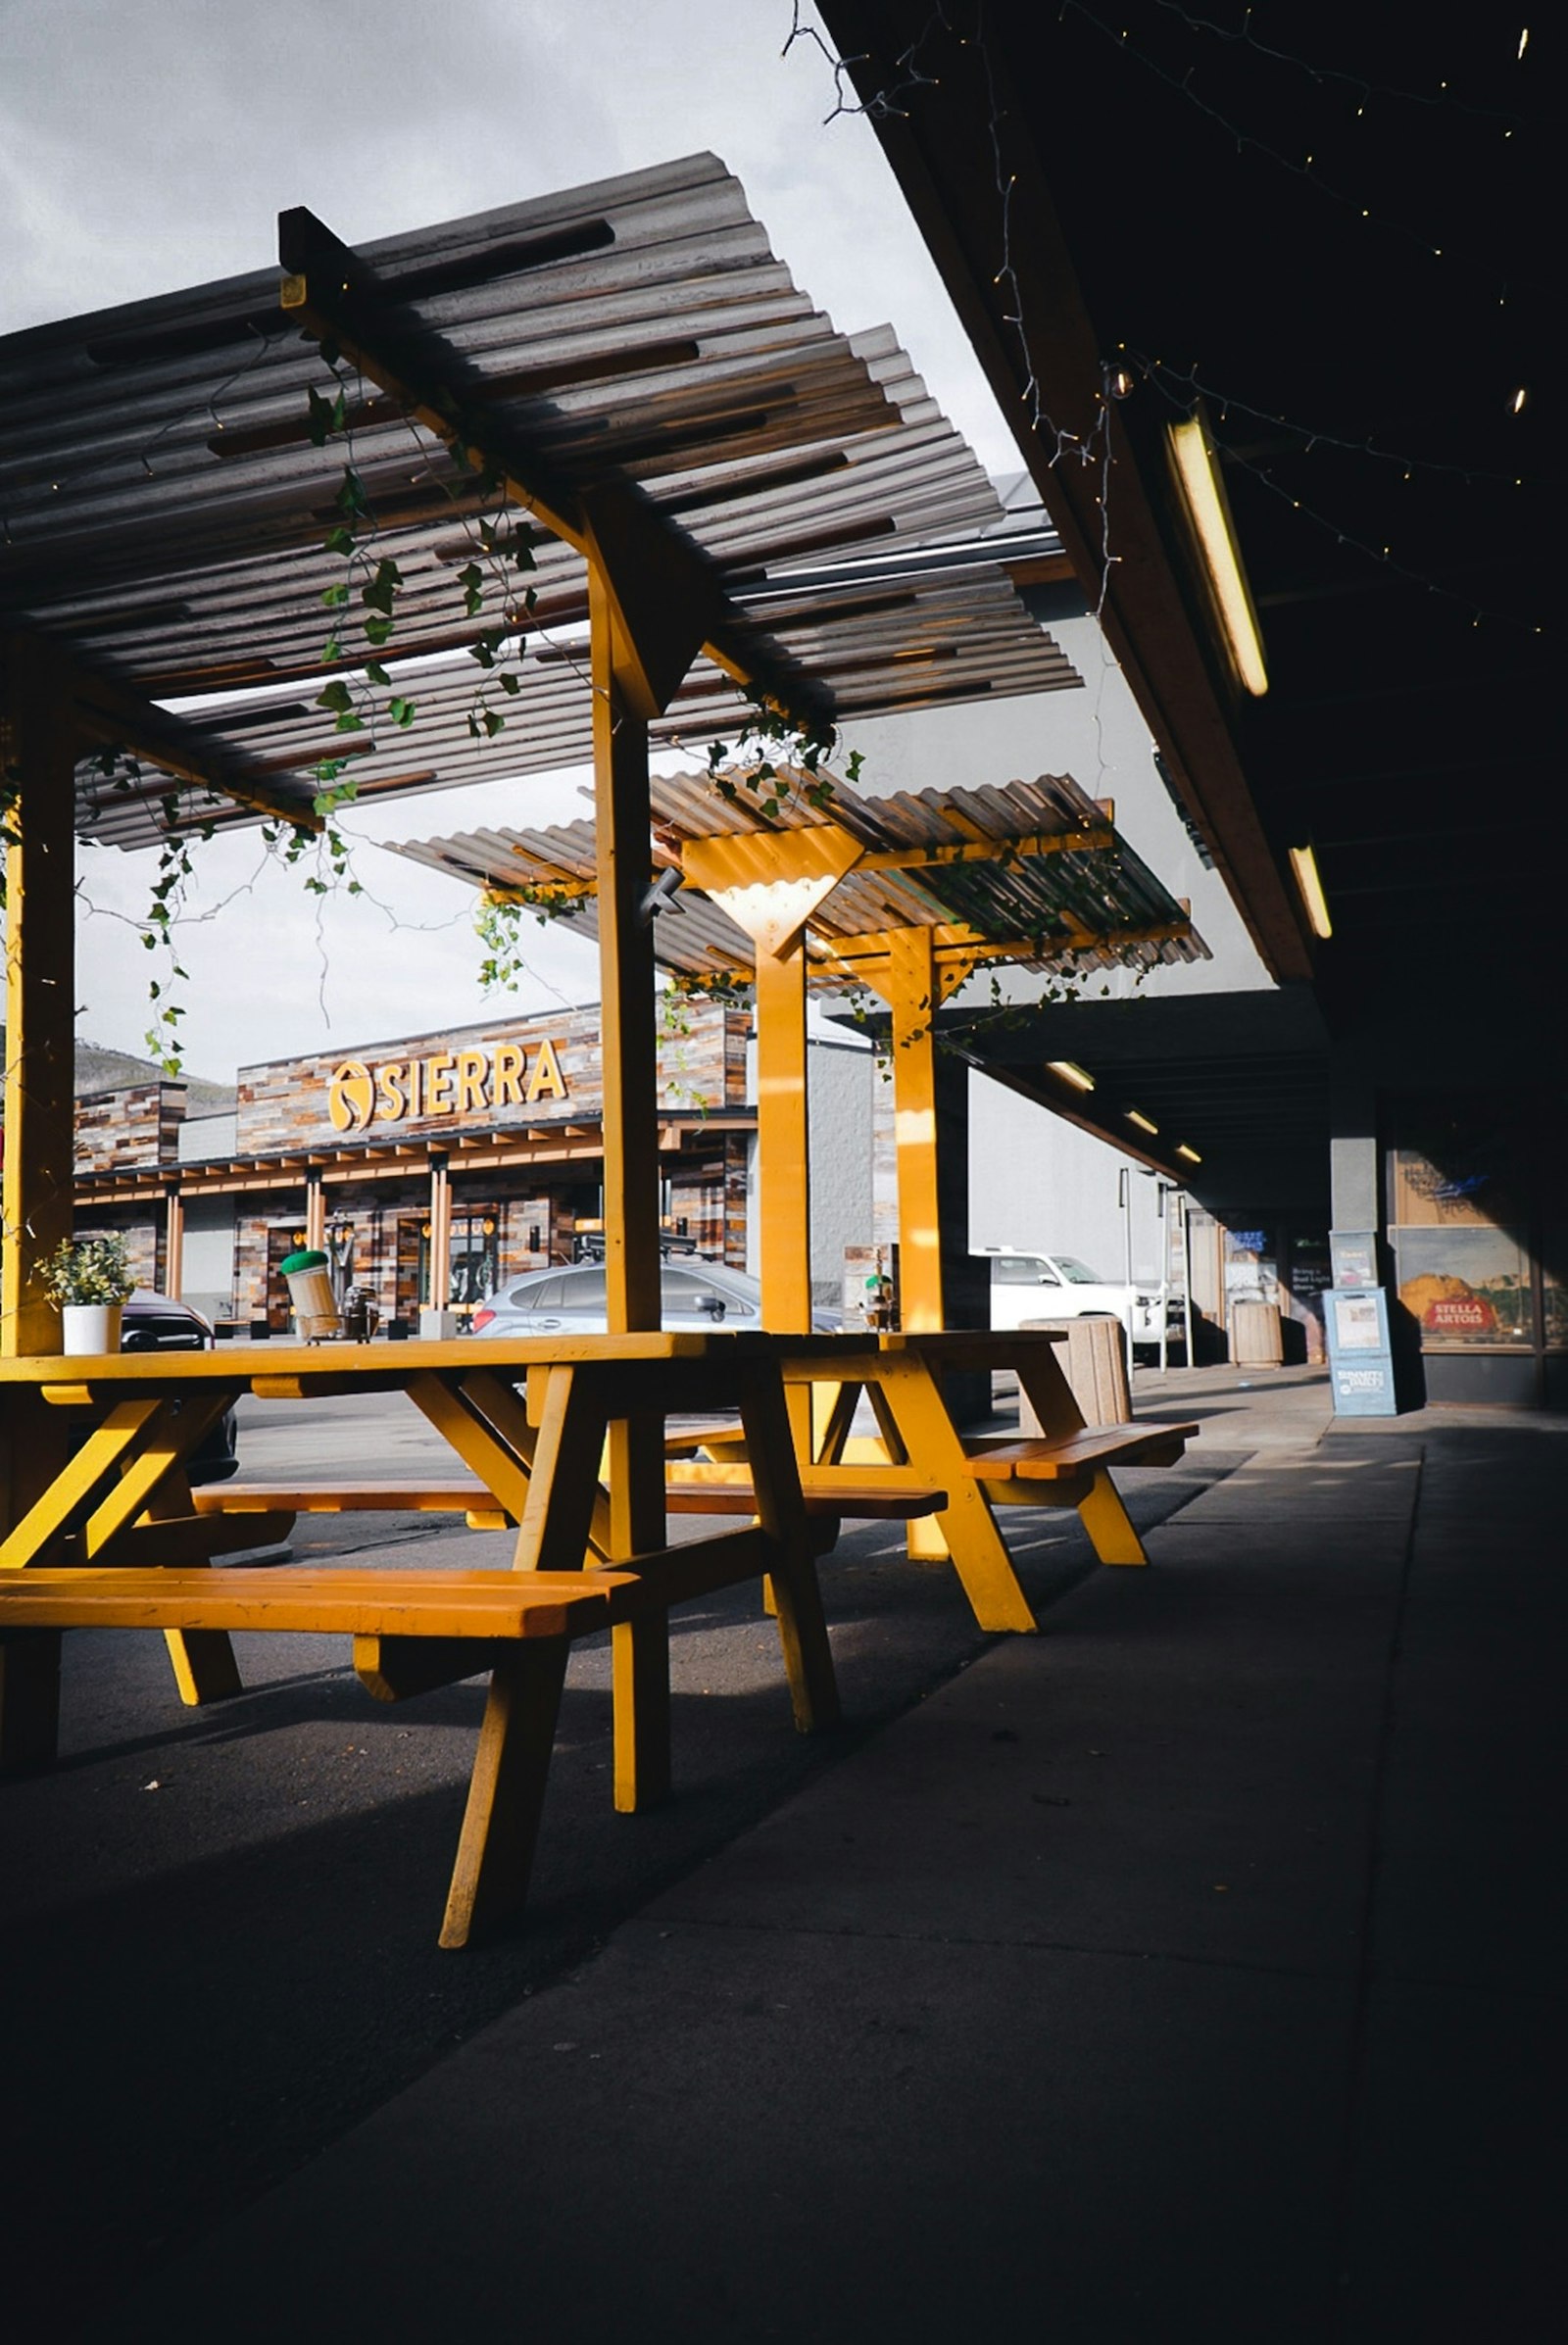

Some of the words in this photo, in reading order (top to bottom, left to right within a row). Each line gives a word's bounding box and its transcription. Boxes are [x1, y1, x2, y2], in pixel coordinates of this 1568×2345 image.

[379, 1038, 567, 1121] SIERRA
[1434, 1304, 1483, 1314] STELLA
[1434, 1314, 1484, 1324] ARTOIS
